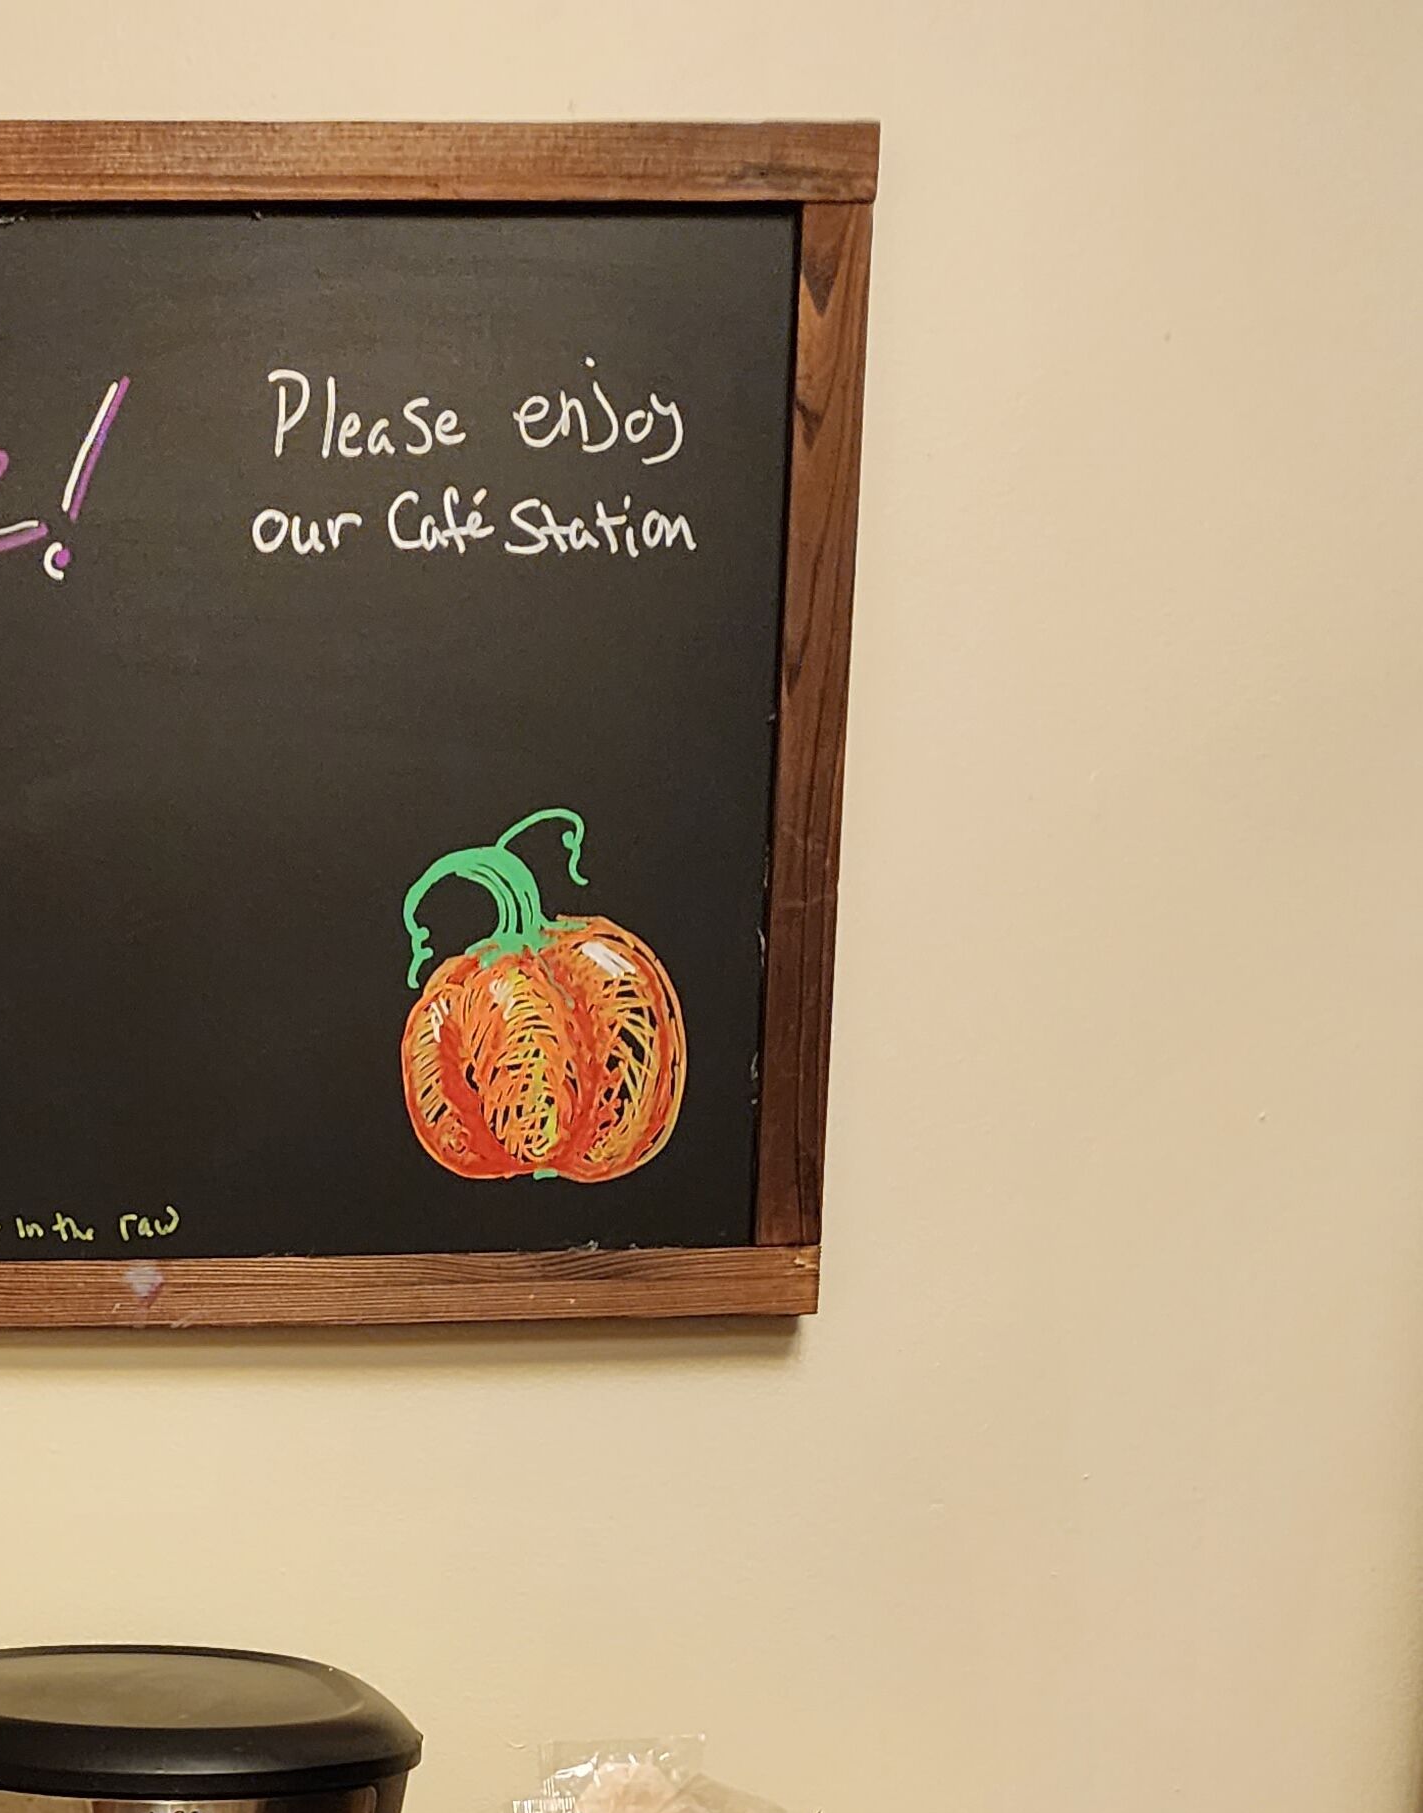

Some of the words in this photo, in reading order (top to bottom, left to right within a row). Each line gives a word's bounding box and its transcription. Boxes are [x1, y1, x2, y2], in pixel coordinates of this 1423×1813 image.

[267, 368, 467, 459] Please
[512, 356, 684, 465] enjoy
[252, 508, 363, 555] our
[387, 486, 495, 554] Café
[504, 495, 697, 558] Station
[51, 1212, 94, 1242] the
[119, 1205, 180, 1241] raw
